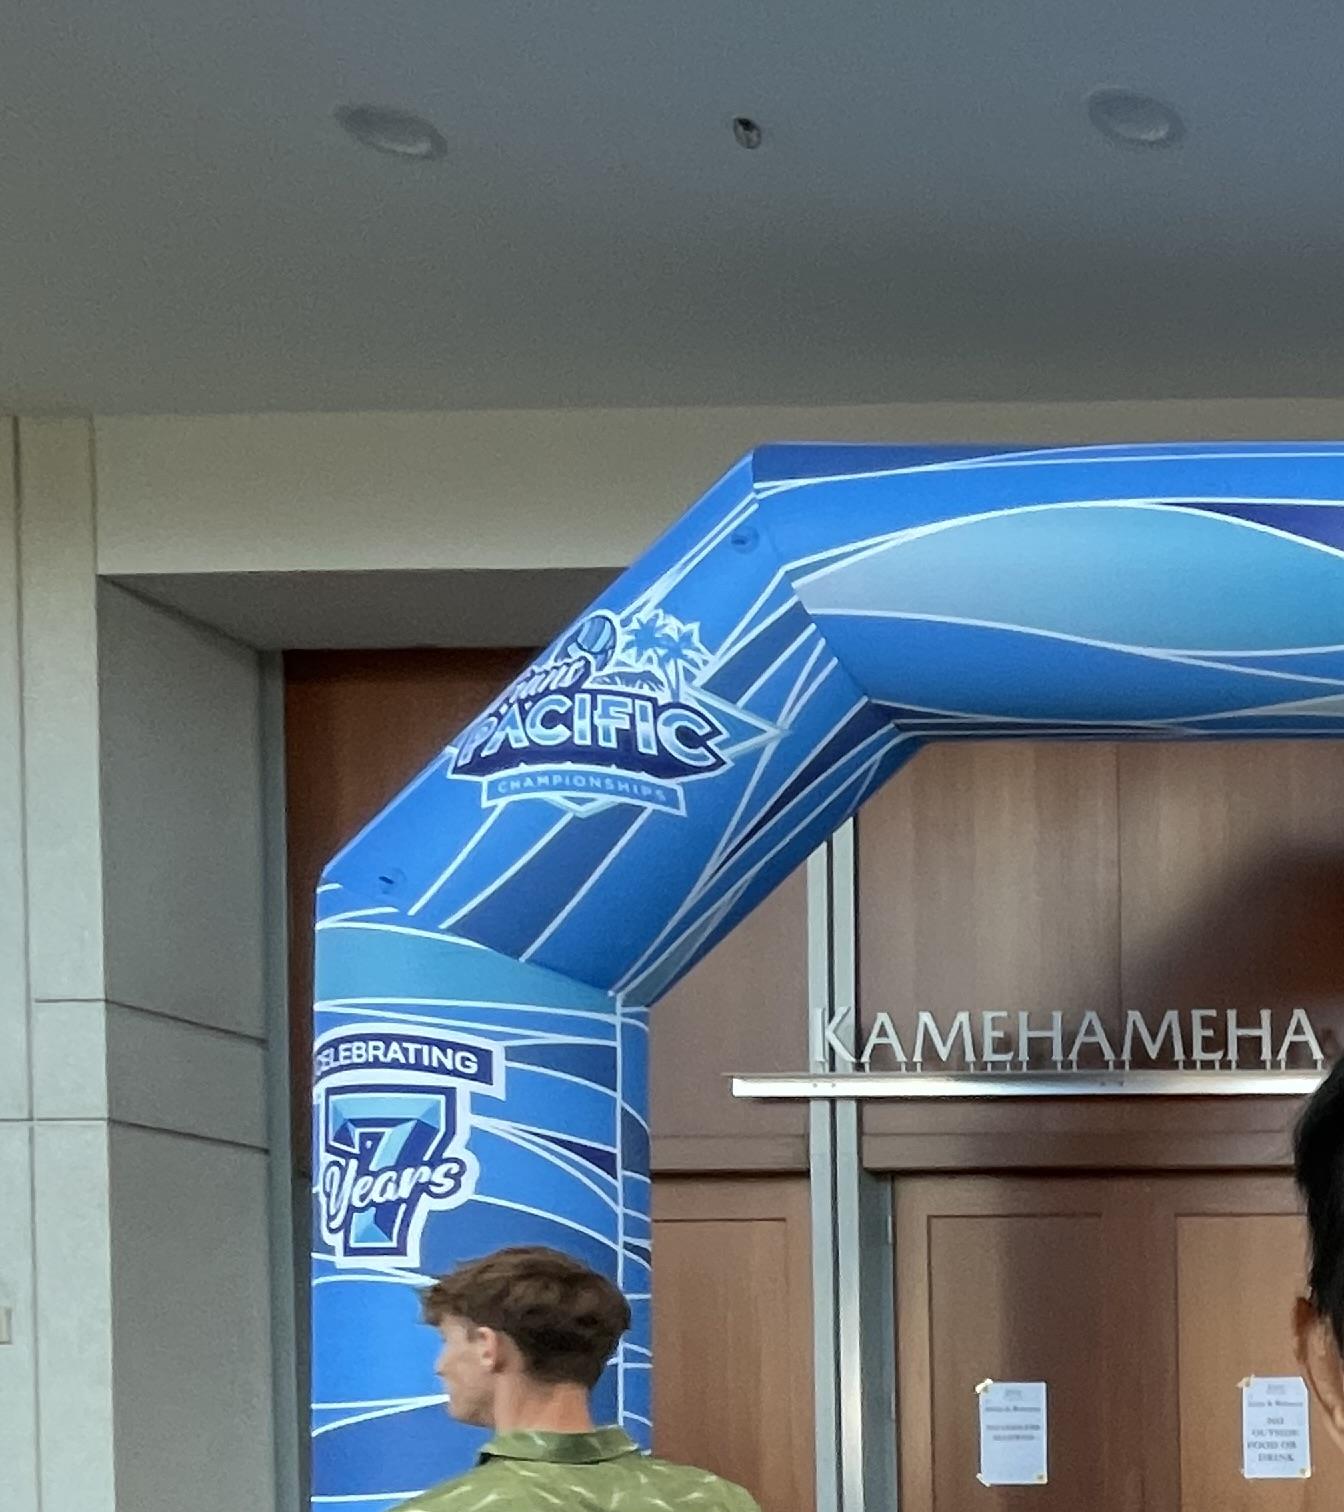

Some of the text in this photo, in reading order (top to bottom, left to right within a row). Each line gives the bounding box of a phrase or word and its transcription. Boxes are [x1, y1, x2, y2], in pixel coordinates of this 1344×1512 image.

[457, 692, 716, 768] PACIFIC
[496, 778, 666, 801] CHAMPIONSHIPS
[808, 1004, 1326, 1063] KAMEHAMEHA
[323, 1156, 463, 1231] Years
[325, 1084, 457, 1257] 7
